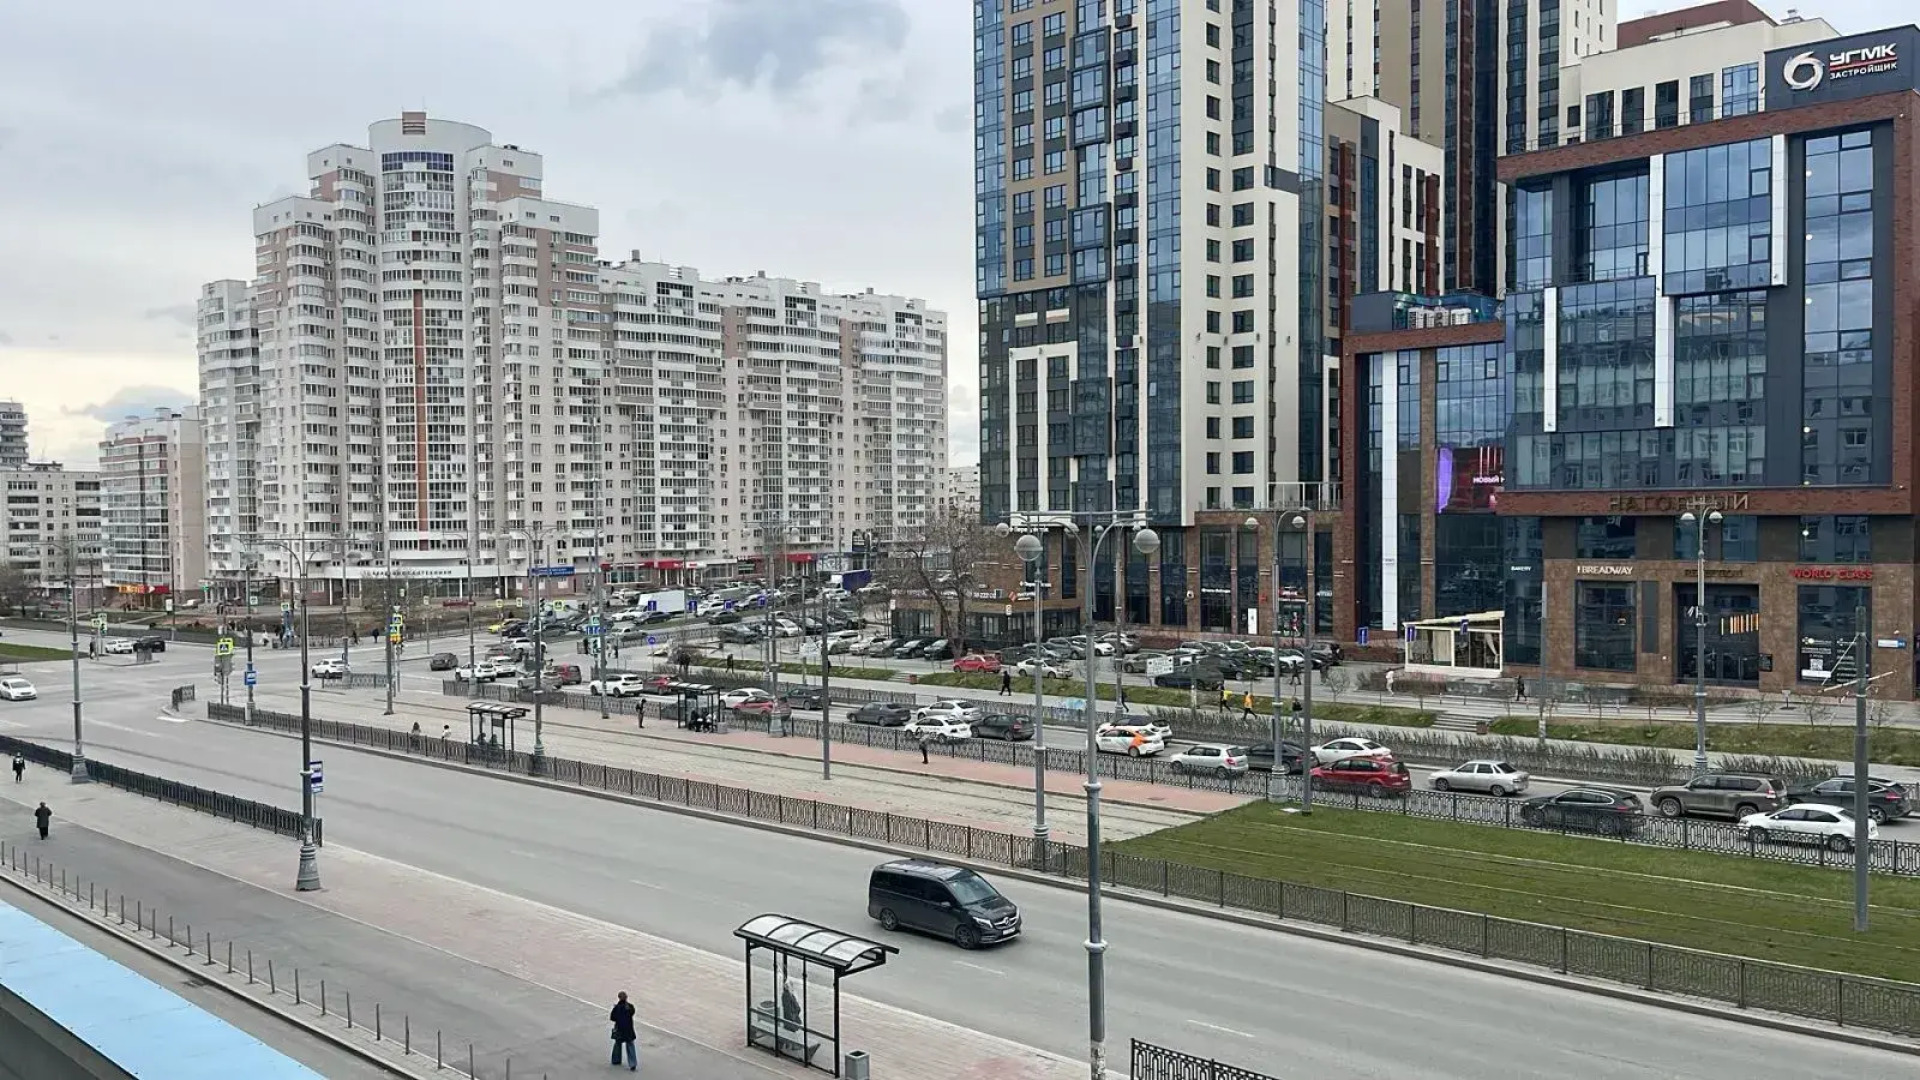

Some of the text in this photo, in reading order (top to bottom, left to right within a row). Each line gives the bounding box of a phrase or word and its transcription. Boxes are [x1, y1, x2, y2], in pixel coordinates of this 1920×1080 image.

[1829, 43, 1897, 66] УГМК
[1829, 62, 1897, 80] ЗАСТРОЙЩИК
[1582, 565, 1633, 575] BREADWAY
[1791, 568, 1873, 579] WORLD CLASS
